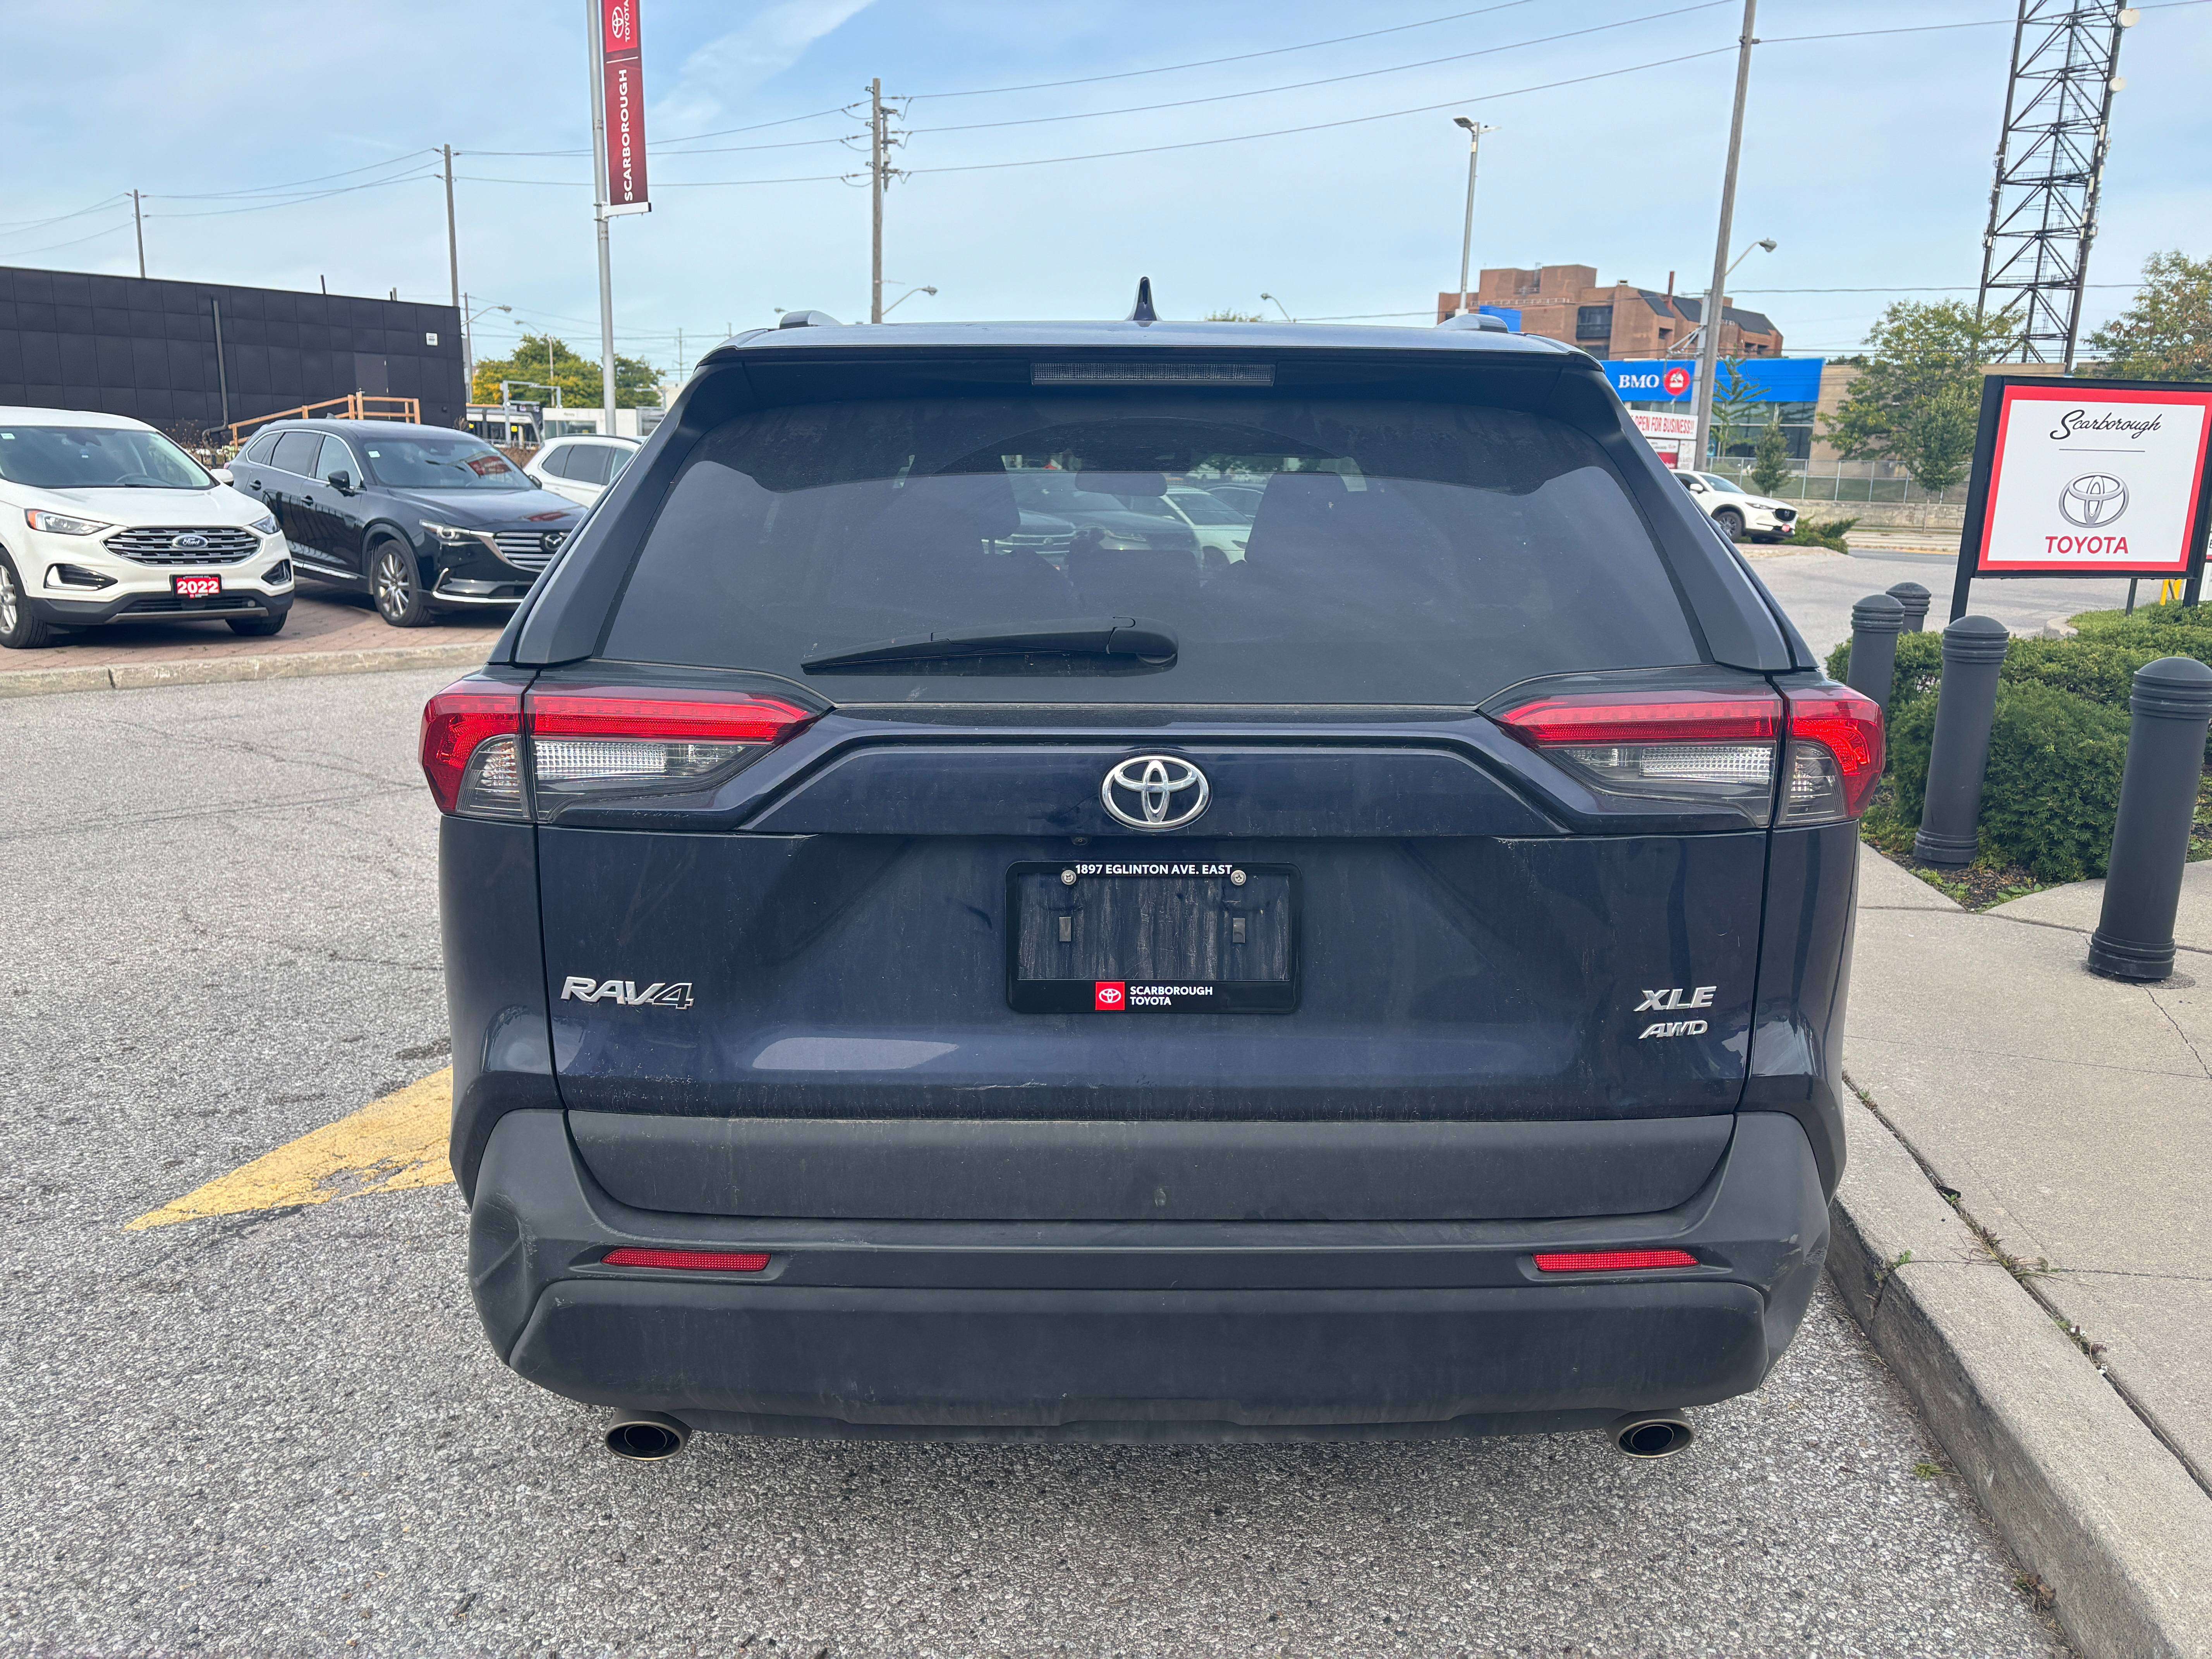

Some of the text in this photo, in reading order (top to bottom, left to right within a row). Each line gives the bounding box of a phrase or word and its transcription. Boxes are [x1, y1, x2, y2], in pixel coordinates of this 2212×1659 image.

[618, 69, 633, 201] SCARBOROUGH
[1618, 374, 1659, 388] BMO
[1651, 417, 1662, 432] FOR
[2050, 409, 2162, 440] Scarborough
[2045, 536, 2129, 554] TOYOTA
[177, 580, 220, 594] 2022
[1075, 865, 1232, 874] 1897 EGLINTON AVE. EAST
[560, 976, 694, 1010] RAV4
[1130, 986, 1213, 995] SCARBOROUGH
[1130, 996, 1171, 1005] TOYOTA
[1633, 986, 1717, 1012] XLE
[1638, 1020, 1708, 1039] AWD
